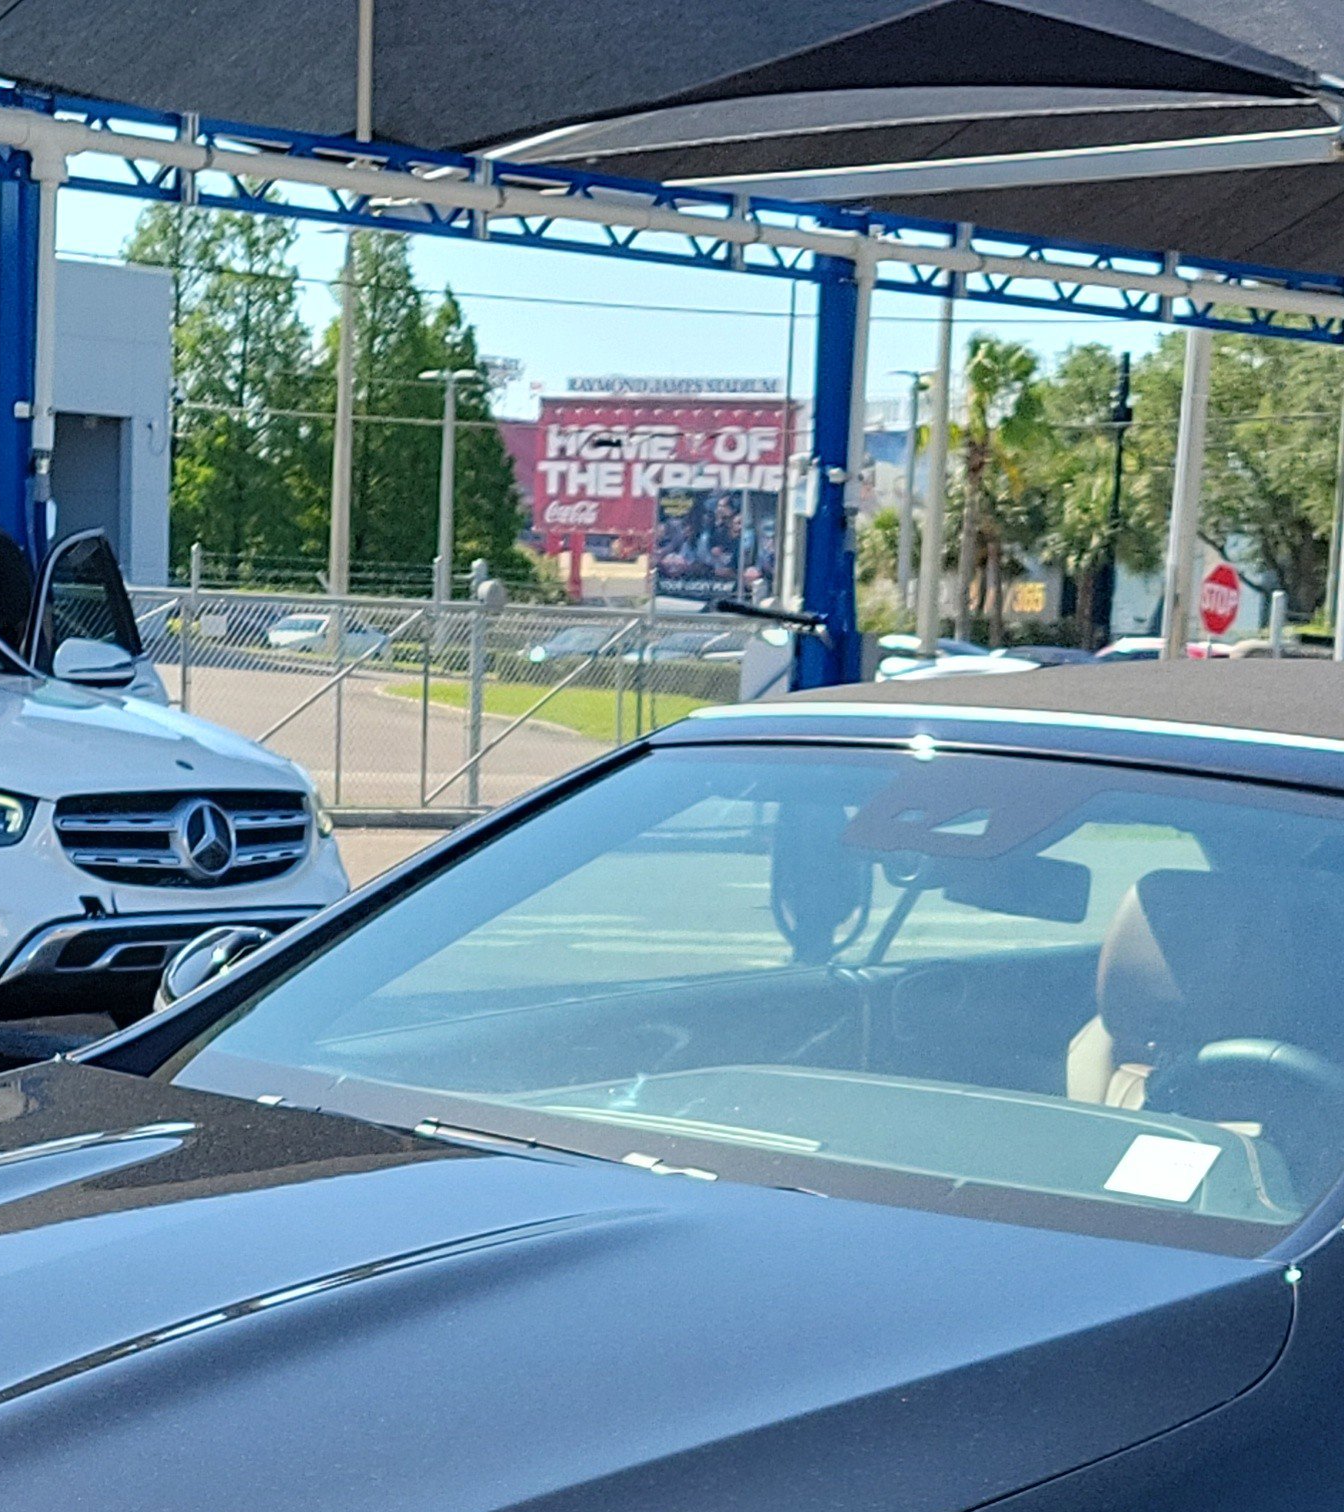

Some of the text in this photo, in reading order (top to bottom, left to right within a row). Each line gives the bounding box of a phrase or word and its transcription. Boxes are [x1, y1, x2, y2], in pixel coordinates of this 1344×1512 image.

[545, 423, 779, 463] HOME OF
[537, 460, 625, 497] THE
[1201, 585, 1239, 613] STOP
